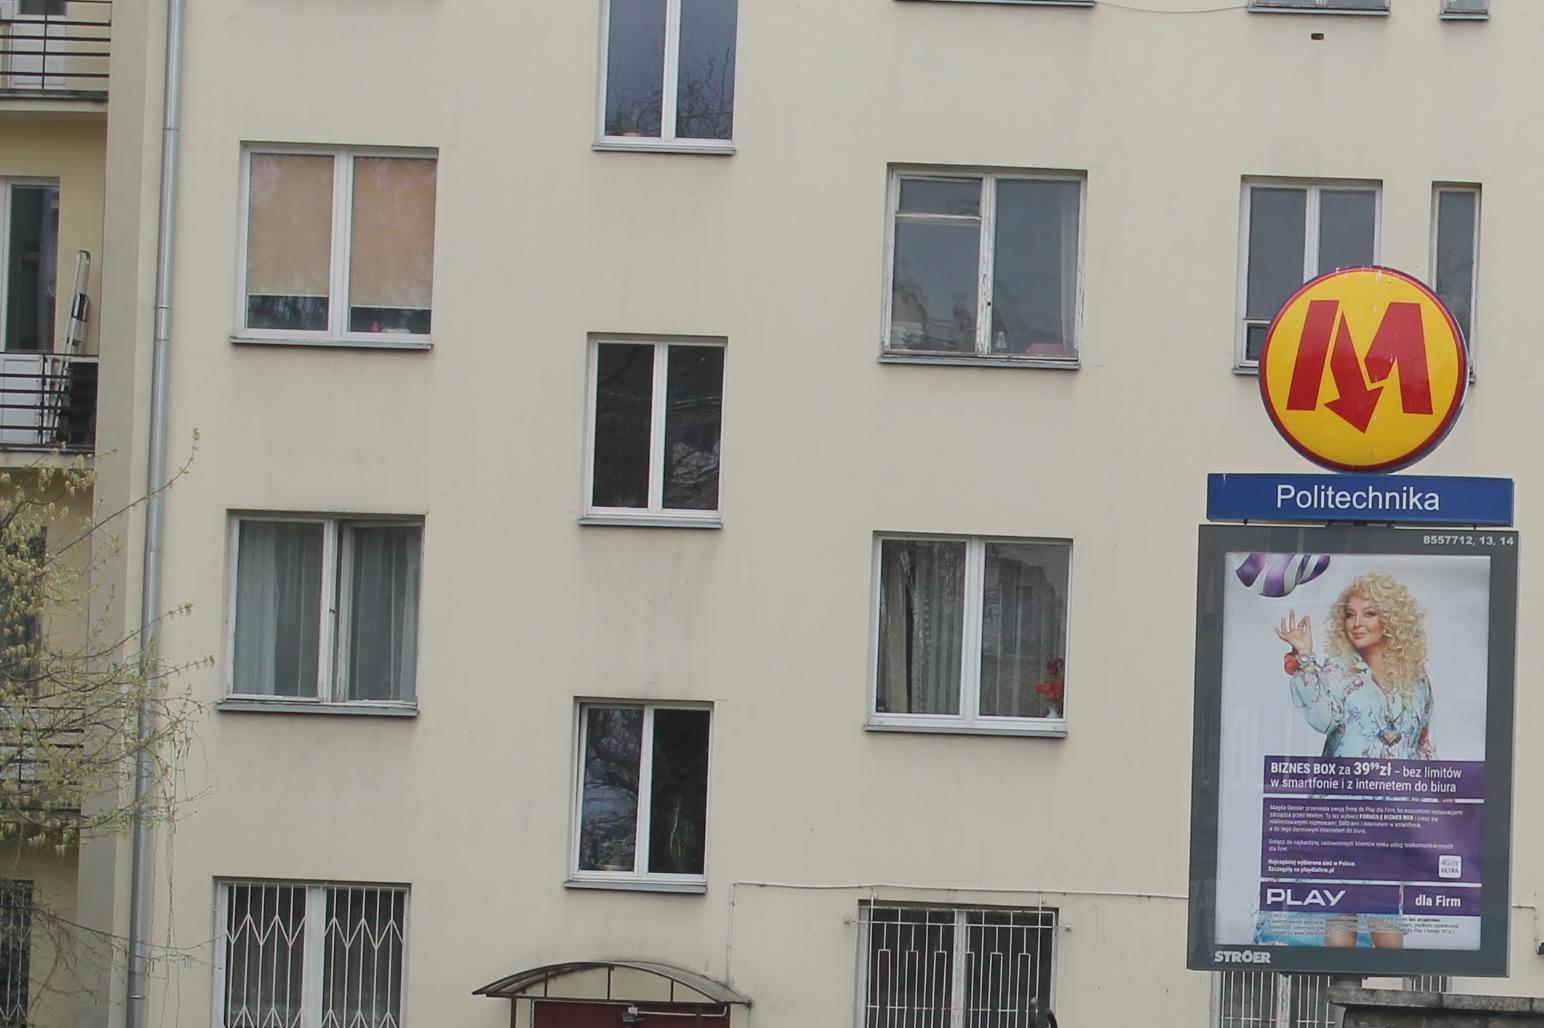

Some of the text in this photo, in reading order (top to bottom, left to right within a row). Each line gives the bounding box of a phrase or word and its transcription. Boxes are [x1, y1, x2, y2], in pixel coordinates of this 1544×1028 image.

[1277, 484, 1440, 511] Politechnika
[1423, 535, 1514, 546] 8557712, 13, 14
[1271, 762, 1310, 774] BIZNES
[1313, 763, 1336, 775] BOX
[1338, 766, 1350, 775] za
[1402, 765, 1421, 778] bez
[1424, 766, 1462, 779] limitów
[1282, 777, 1338, 789] smartfonie
[1355, 779, 1411, 791] internetem
[1414, 780, 1427, 792] do
[1430, 780, 1456, 792] biura
[1266, 888, 1345, 906] PLAY
[1415, 895, 1461, 907] dla Firm
